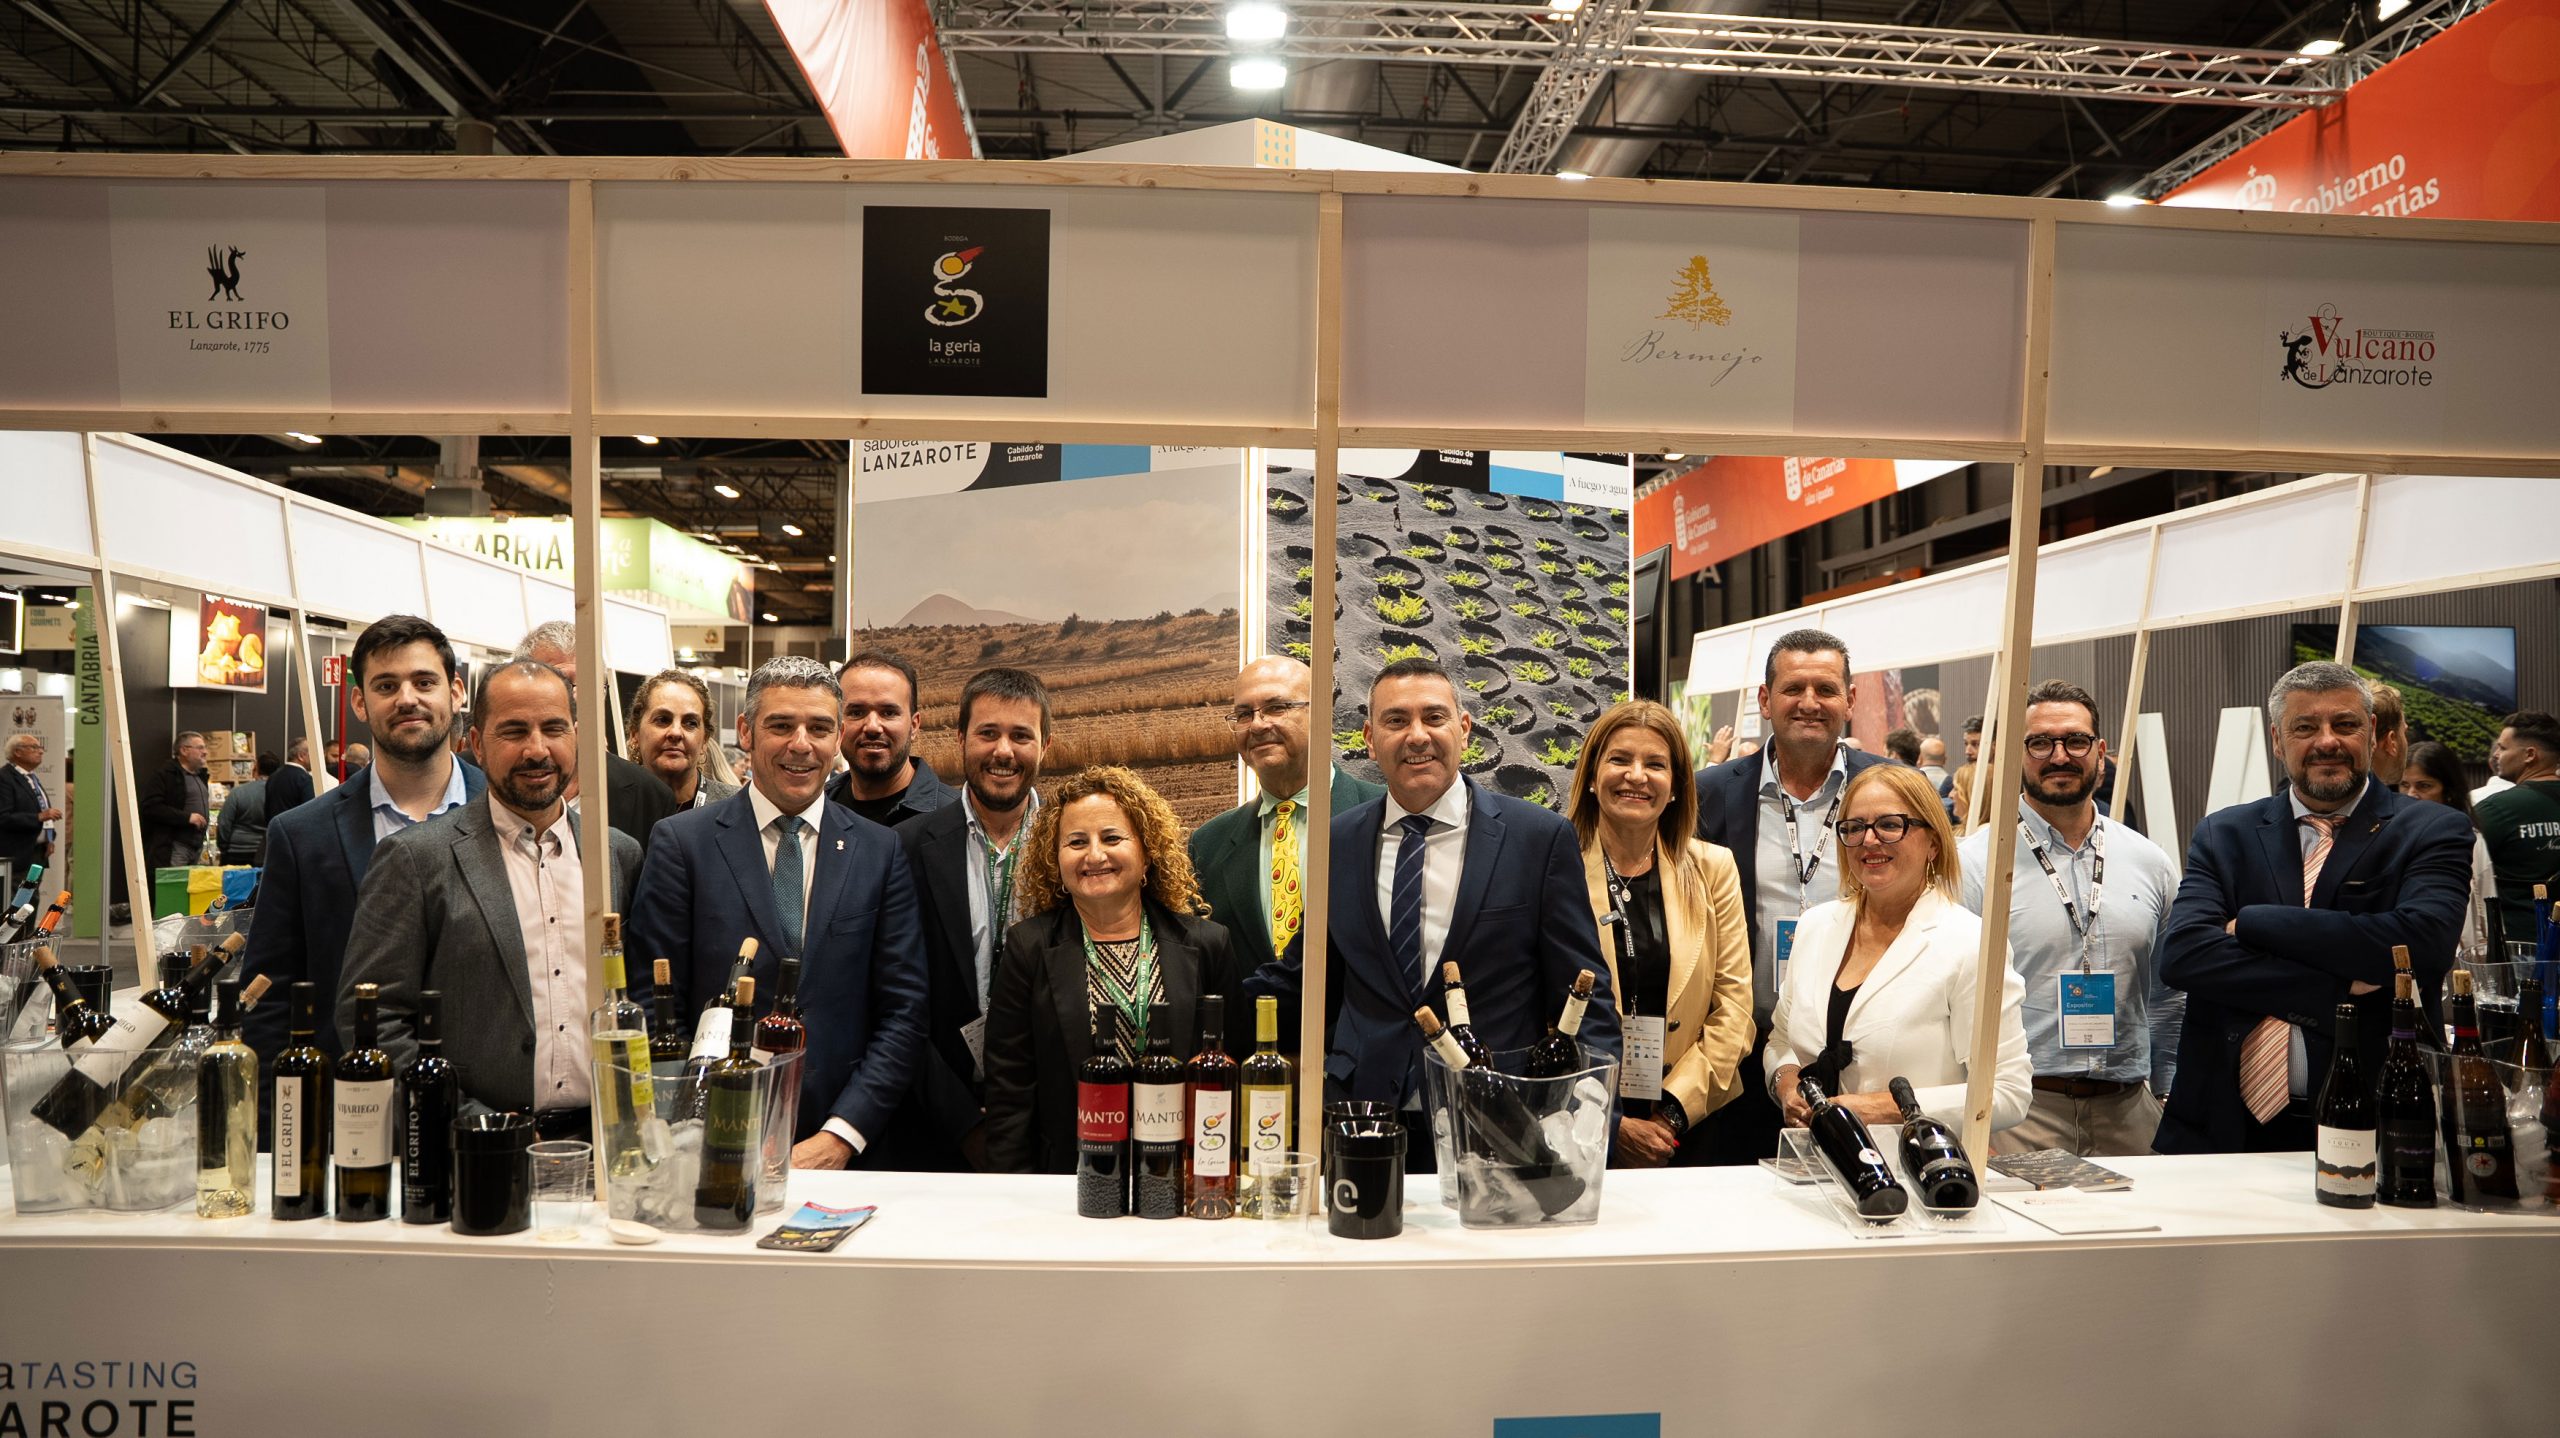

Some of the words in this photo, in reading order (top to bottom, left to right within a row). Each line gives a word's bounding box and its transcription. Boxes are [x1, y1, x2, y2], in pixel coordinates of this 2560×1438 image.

[167, 310, 200, 329] EL
[206, 310, 289, 330] GRIFO
[190, 338, 241, 352] Lanzarote,
[244, 340, 271, 354] 1775
[929, 338, 941, 352] la
[945, 339, 981, 356] geria
[2308, 316, 2436, 362] Vulcano
[928, 357, 981, 365] LANZAROTE
[1620, 329, 1763, 388] Bermejo
[2303, 369, 2317, 381] de
[2318, 363, 2433, 387] Lanzarote
[862, 442, 978, 473] LANZAROTE
[1007, 445, 1034, 456] Cabildo
[1035, 444, 1045, 452] de
[1007, 453, 1043, 464] Lanzarote
[1439, 454, 1473, 466] Lanzarote
[1569, 477, 1577, 488] A
[1577, 477, 1602, 494] fuego
[1602, 483, 1609, 494] y
[1609, 484, 1629, 497] agua
[80, 634, 101, 726] CANTABRIA
[281, 1102, 293, 1148] GRIFO
[1078, 1106, 1126, 1125] MANTO
[1135, 1108, 1184, 1126] MANTO
[408, 1111, 420, 1158] GRIFO
[281, 1151, 293, 1168] EL
[408, 1160, 420, 1177] EL
[0, 1399, 196, 1438] AROTE
